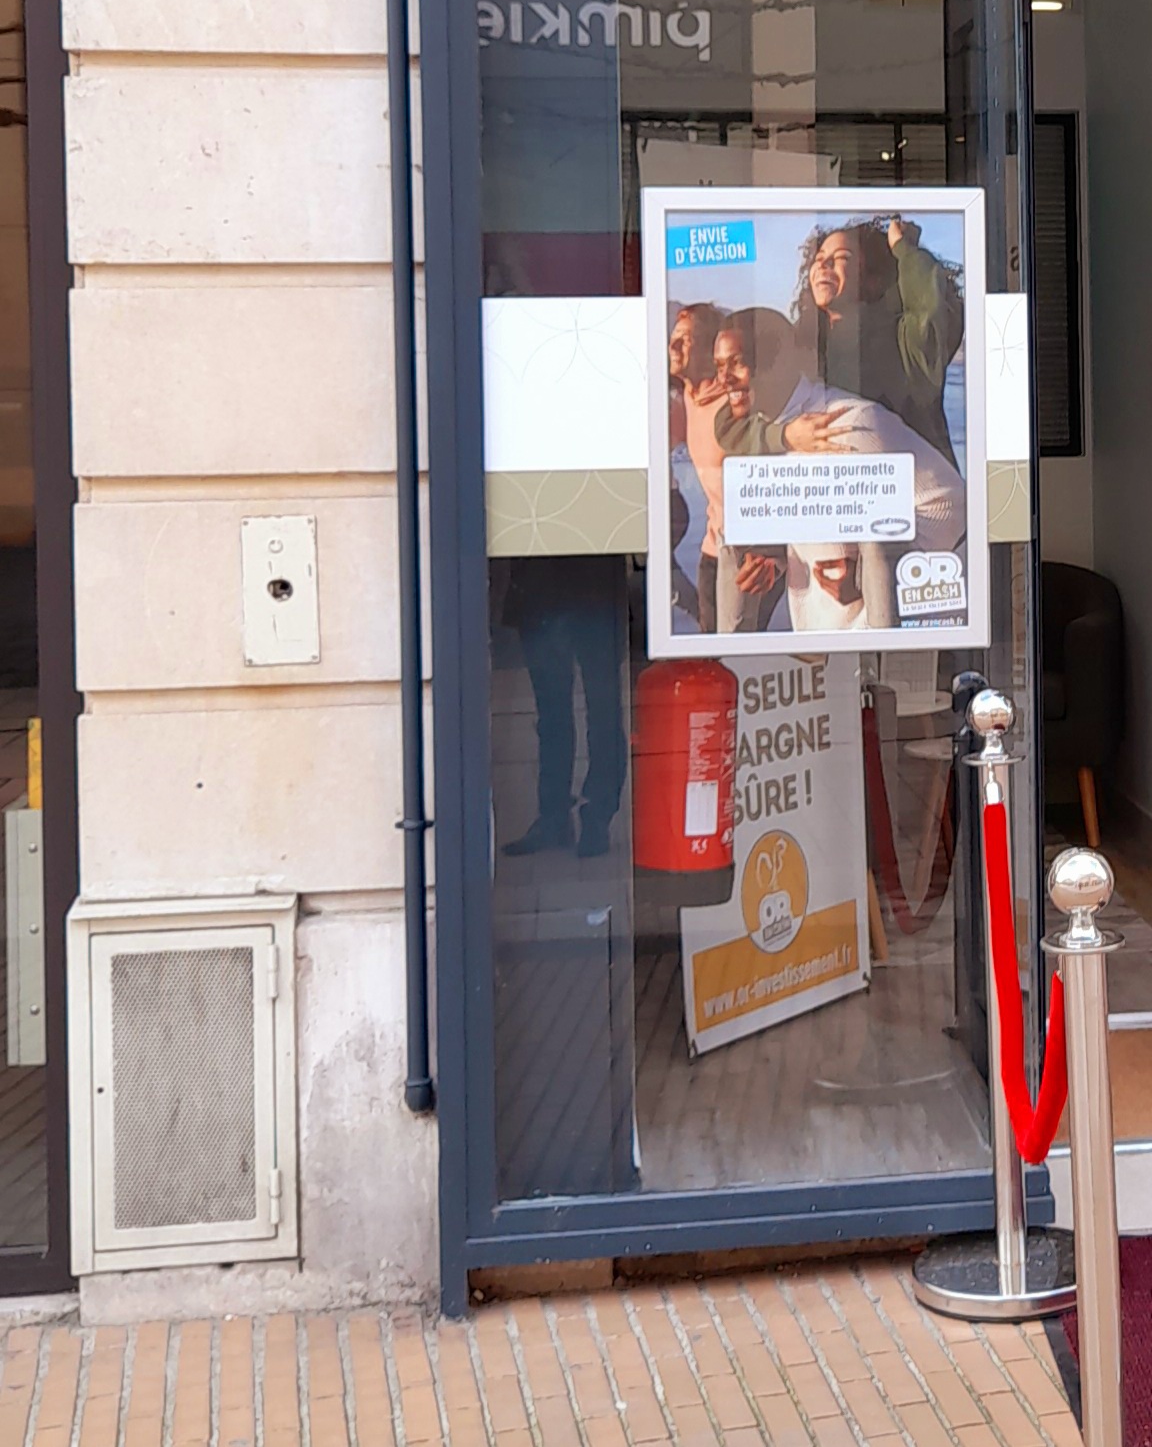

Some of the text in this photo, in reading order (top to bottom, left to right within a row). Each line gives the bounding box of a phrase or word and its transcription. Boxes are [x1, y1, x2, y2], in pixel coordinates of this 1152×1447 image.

[689, 226, 730, 246] ENVIE
[675, 241, 747, 266] D'ÉVASION
[772, 463, 809, 478] vendu
[812, 465, 830, 477] ma
[833, 462, 895, 480] gourmette
[739, 481, 897, 500] défraîchie pour m'offrir un
[739, 503, 798, 517] week-end
[801, 503, 833, 516] entre
[838, 523, 864, 534] Lucas
[900, 555, 960, 587] OR
[904, 588, 922, 603] EN
[742, 663, 826, 715] SEULE
[736, 713, 832, 771] ARGNE
